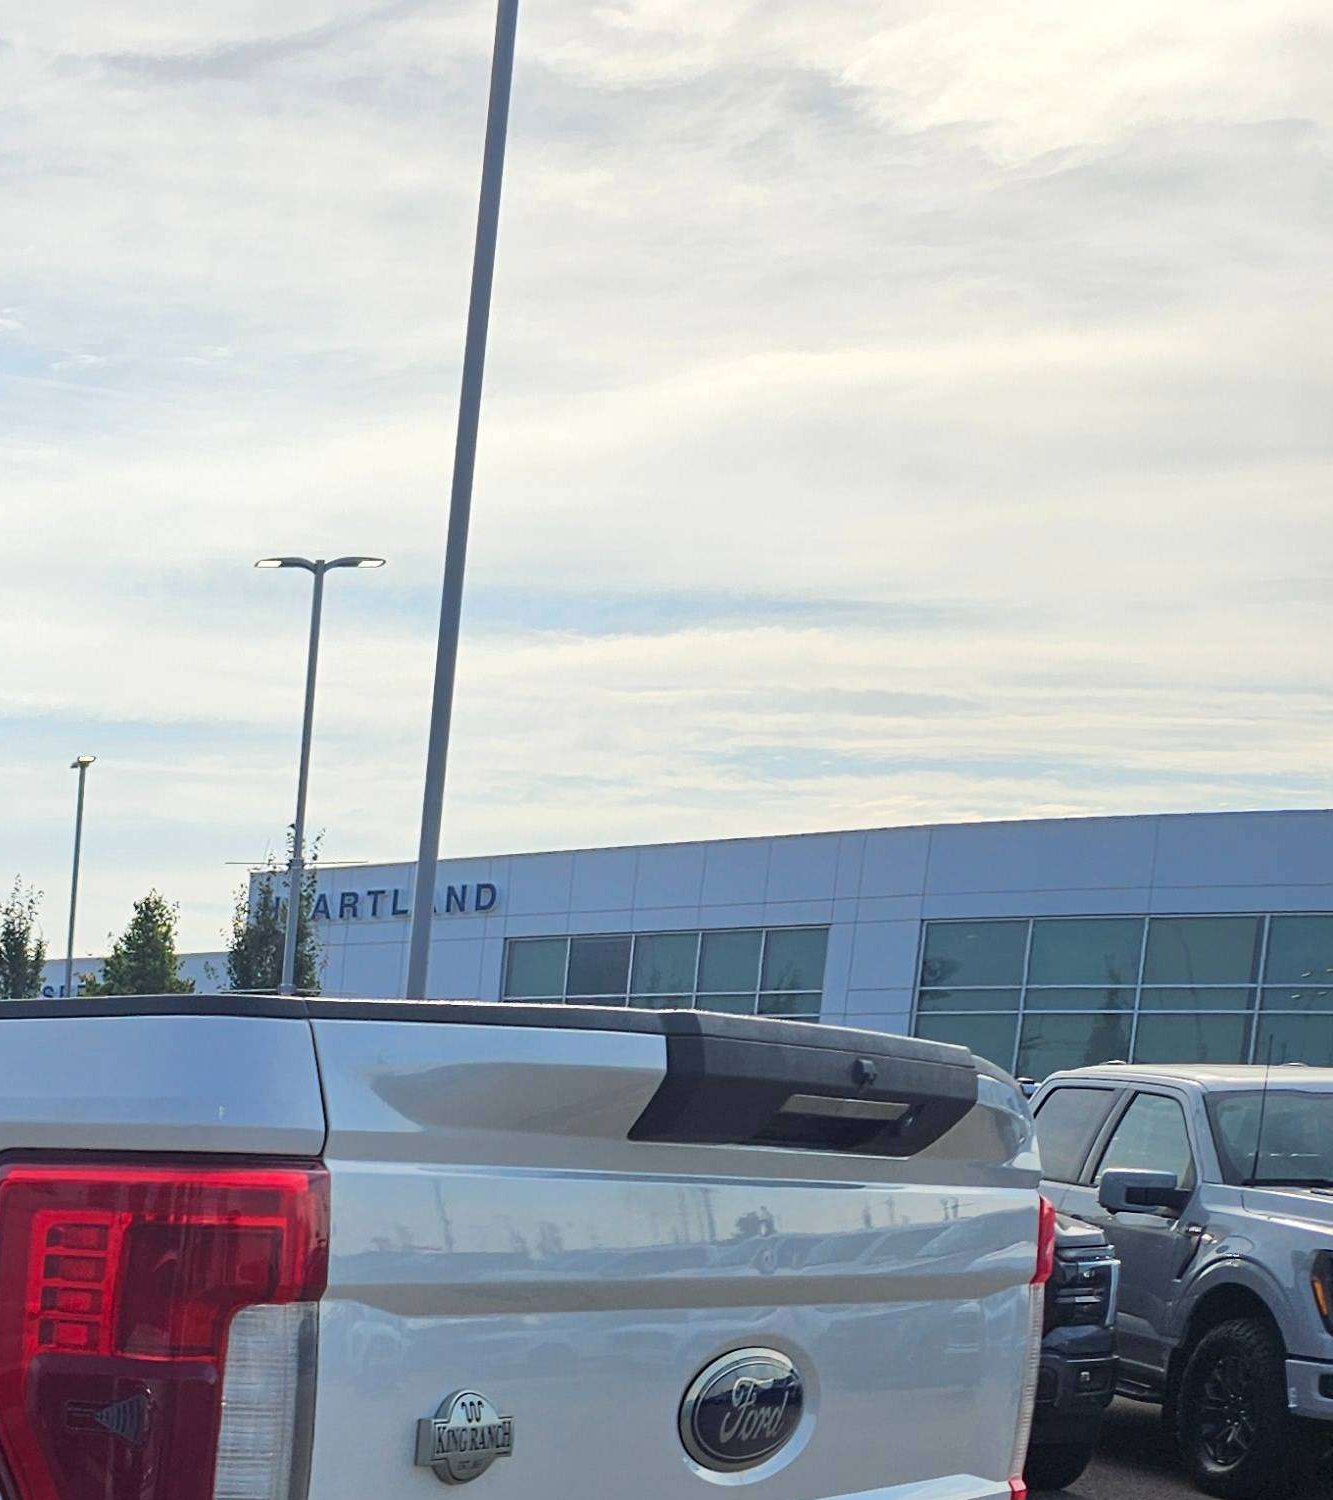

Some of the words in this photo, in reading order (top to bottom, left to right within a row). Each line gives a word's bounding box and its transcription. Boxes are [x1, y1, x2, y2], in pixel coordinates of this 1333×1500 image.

[719, 1376, 789, 1444] Ford
[436, 1425, 467, 1454] KING
[468, 1420, 511, 1452] RANCH
